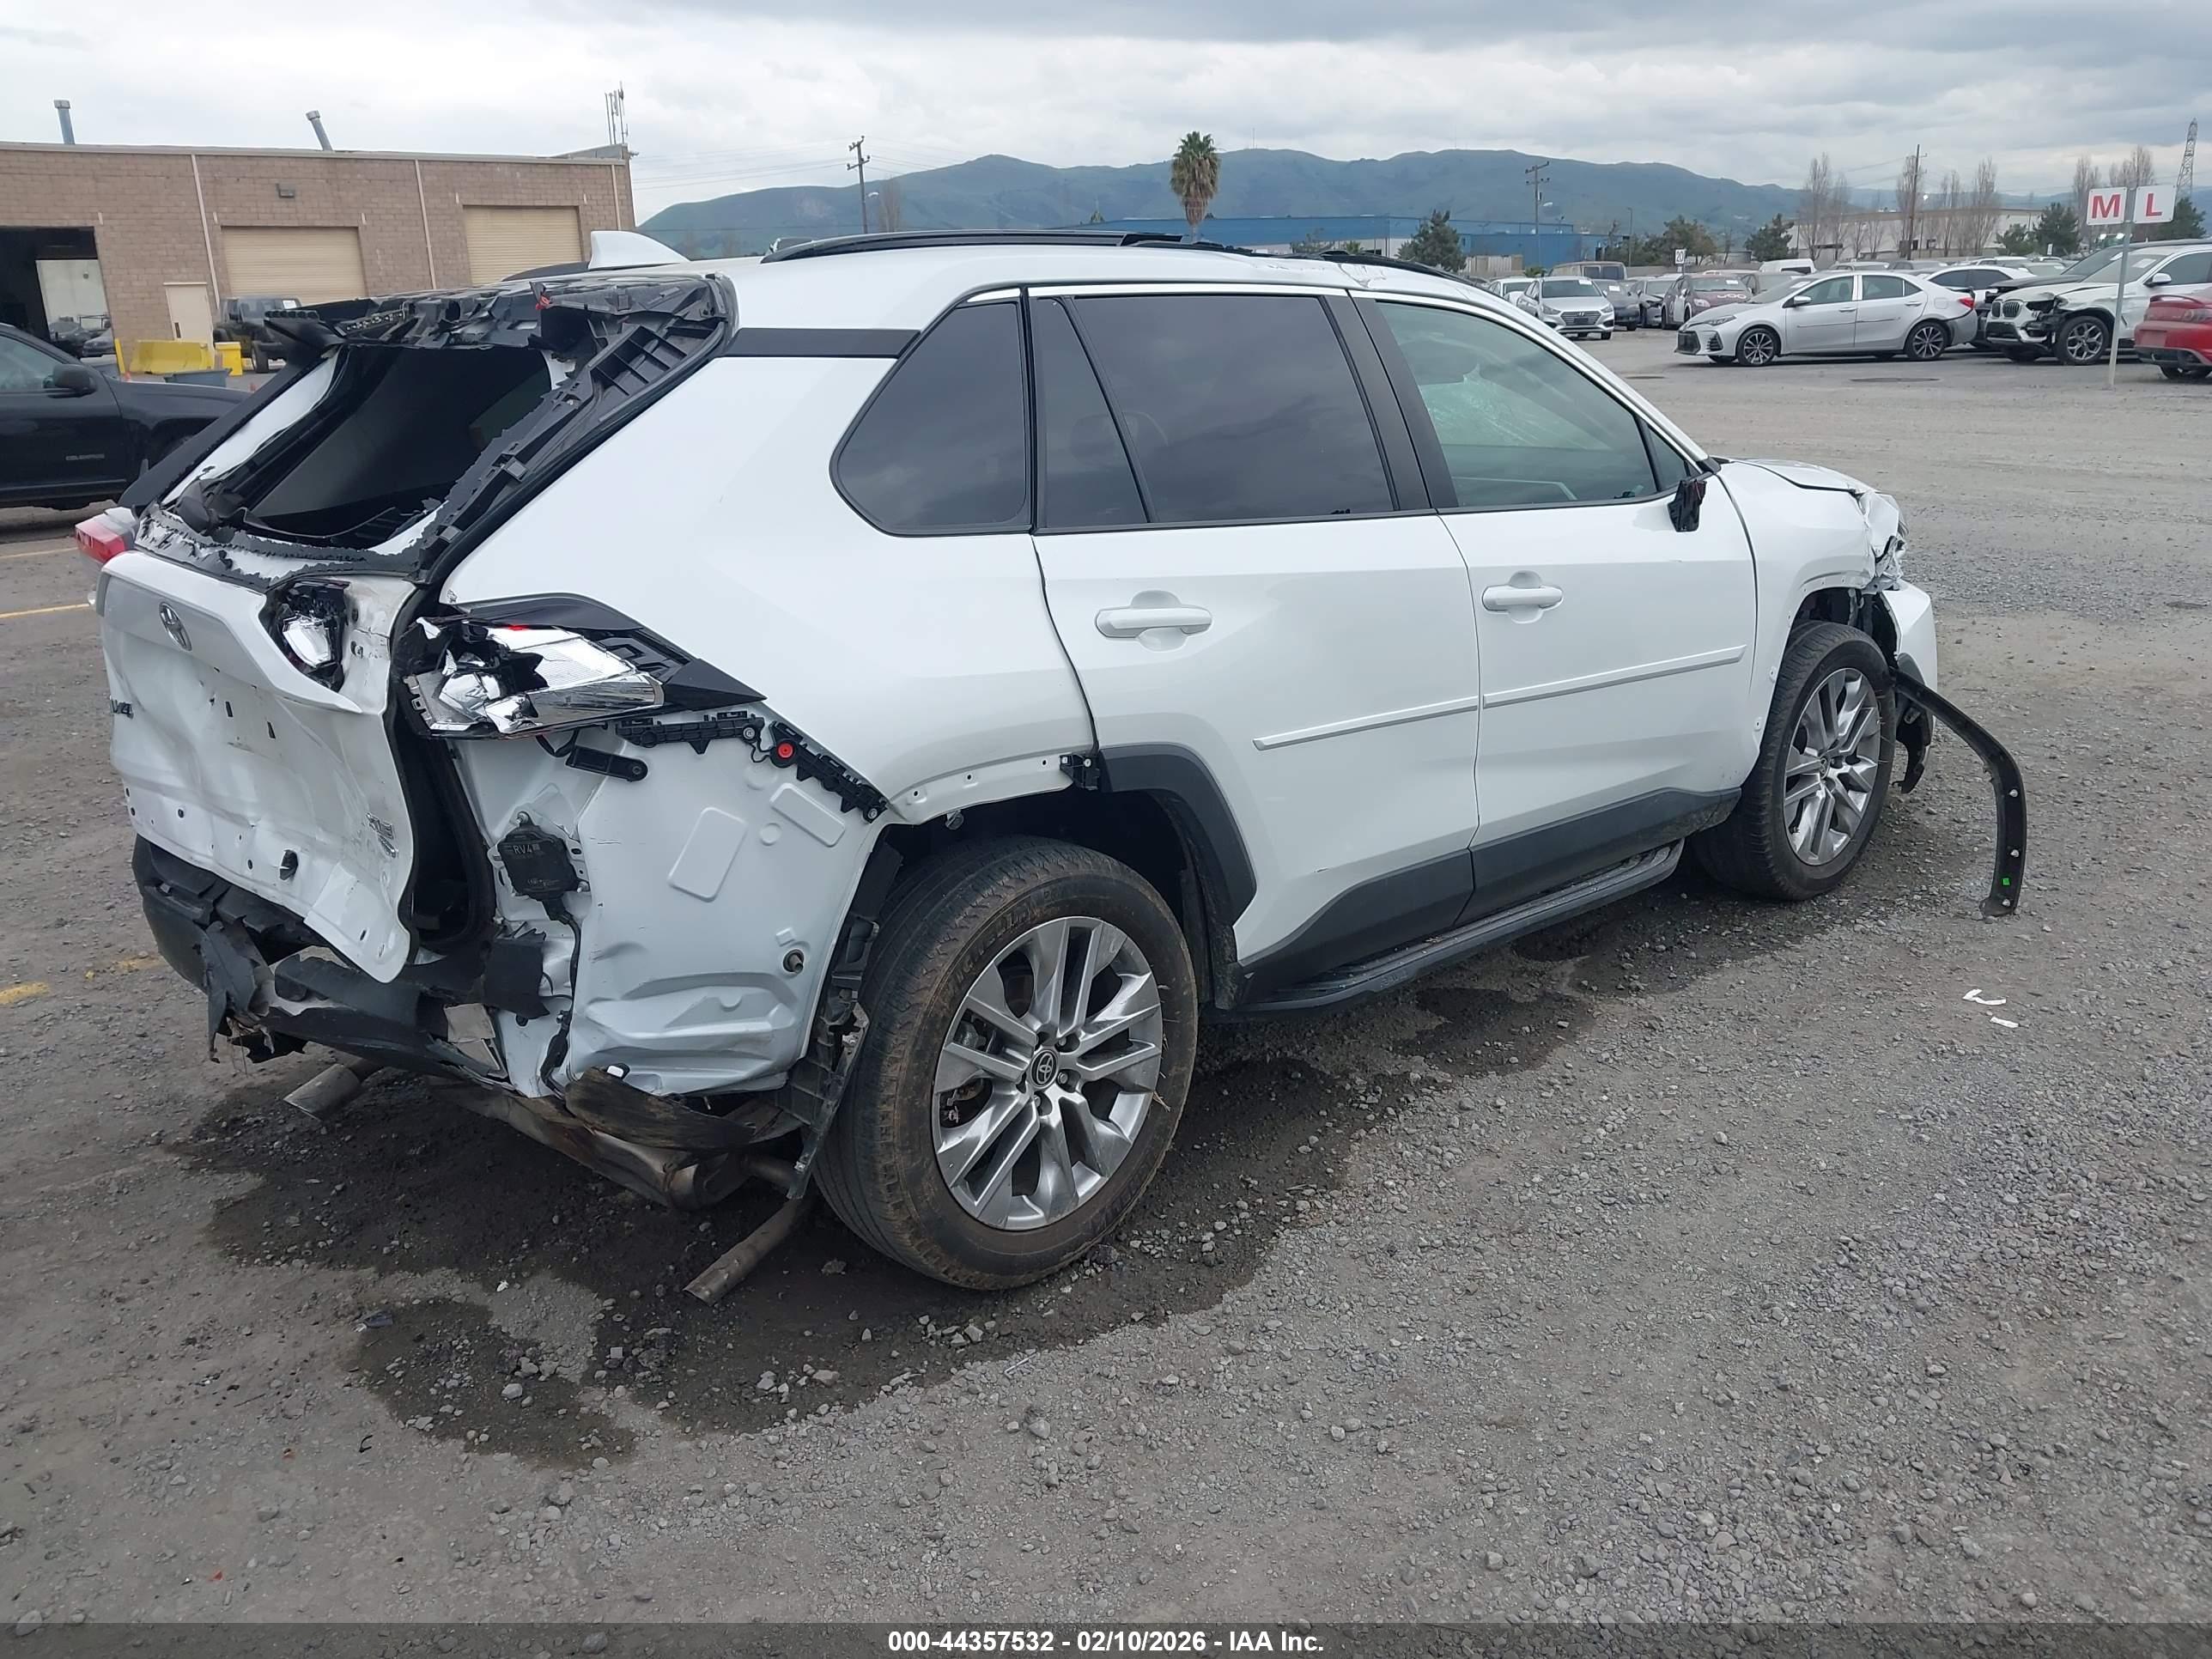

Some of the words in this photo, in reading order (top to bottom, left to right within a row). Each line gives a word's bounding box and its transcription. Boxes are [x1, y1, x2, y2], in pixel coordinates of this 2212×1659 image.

[2092, 194, 2121, 218] M
[2146, 193, 2163, 216] L
[1676, 251, 1684, 262] 20
